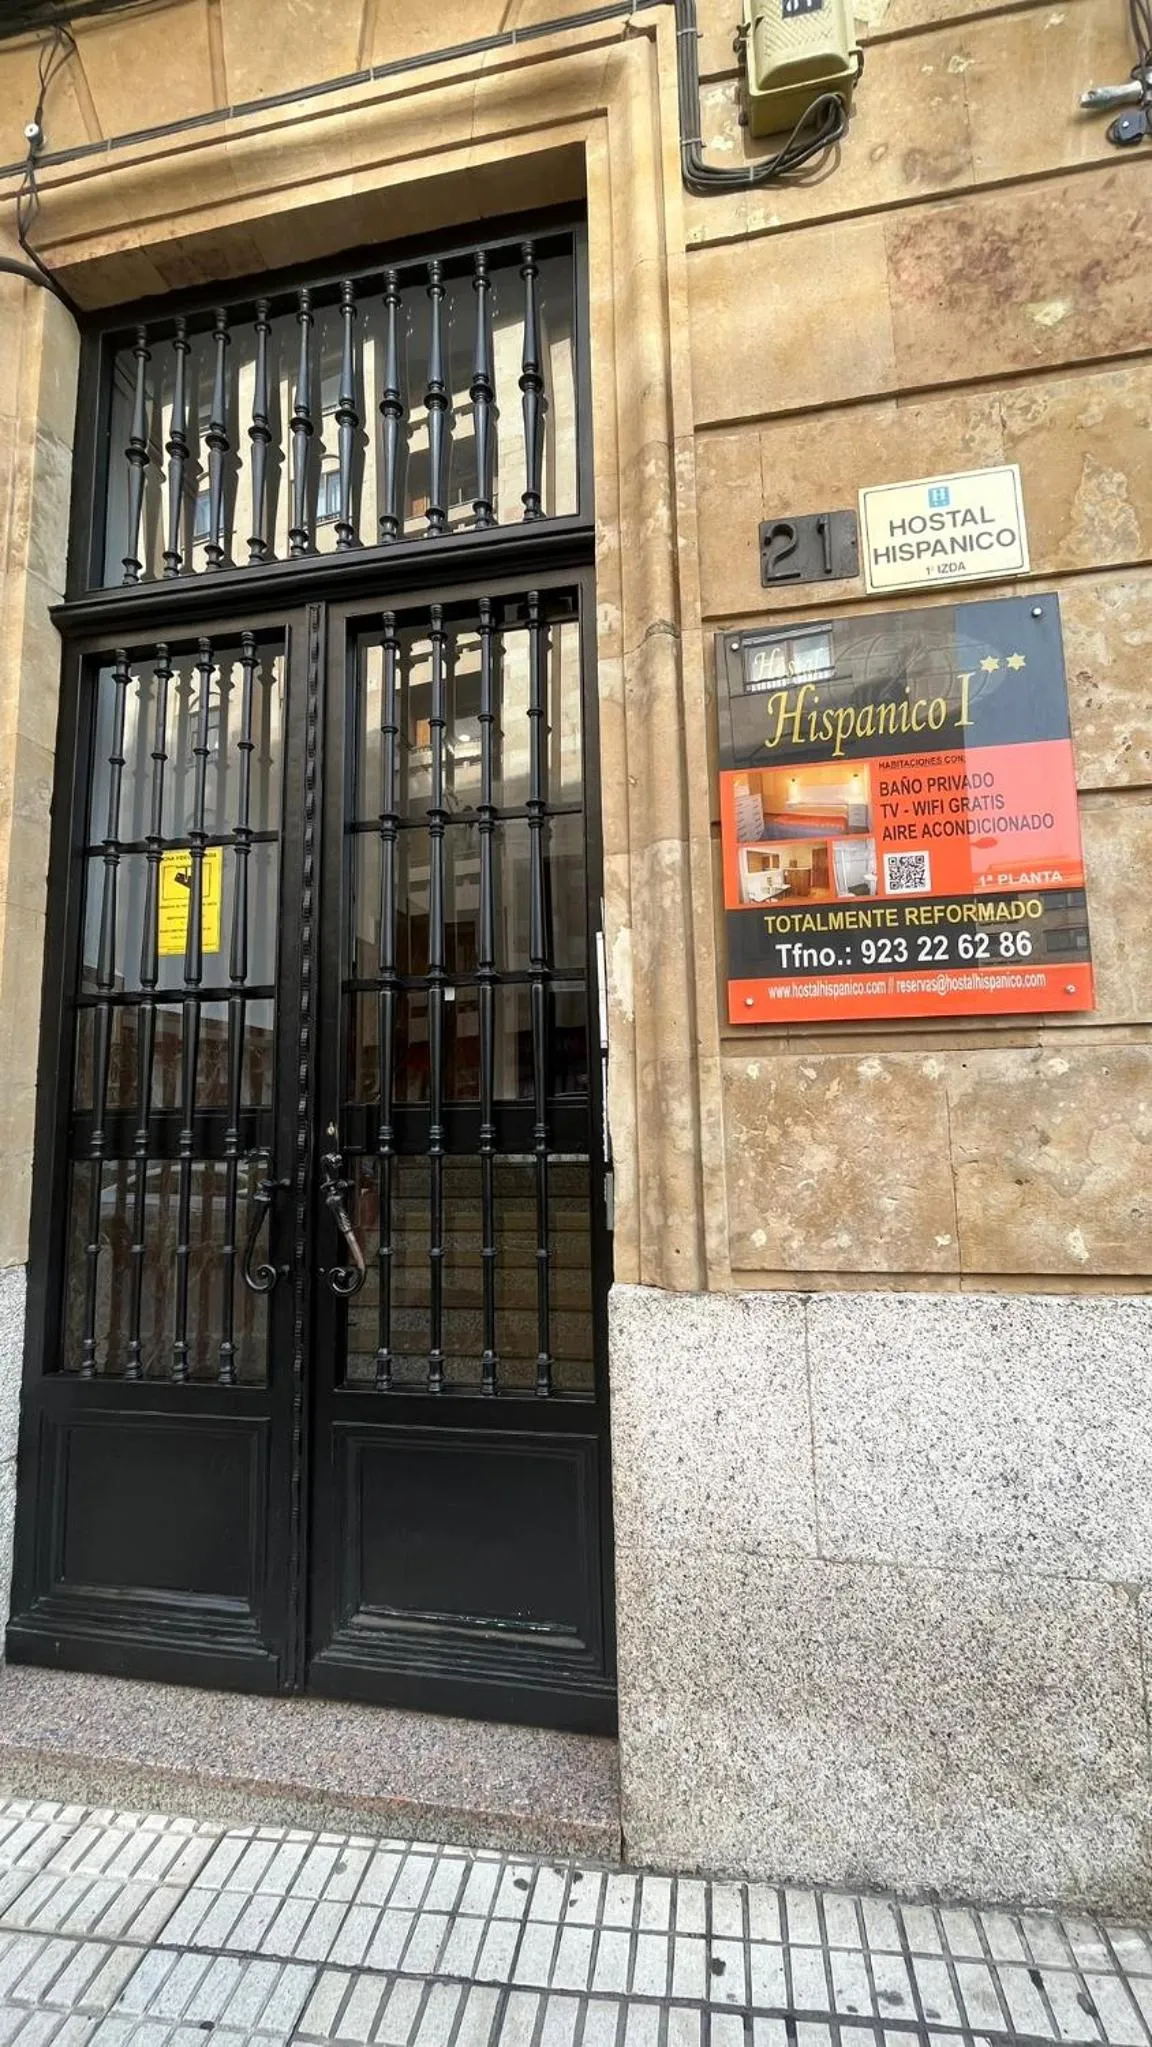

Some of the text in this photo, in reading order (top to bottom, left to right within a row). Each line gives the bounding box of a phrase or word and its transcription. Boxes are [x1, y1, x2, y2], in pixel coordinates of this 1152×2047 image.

[889, 506, 995, 537] HOSTAL
[763, 514, 832, 582] 21
[873, 528, 1016, 566] HISPANICO
[937, 561, 967, 574] IZDA
[765, 671, 977, 756] Hispanico I
[879, 756, 943, 770] HABITACIONES
[880, 772, 994, 797] BAÑO PRIVADO
[880, 803, 899, 819] TV
[912, 799, 944, 817] WIFI
[949, 794, 1005, 813] GRATIS
[883, 813, 1054, 841] AIRE ACONDICIONADO
[998, 870, 1063, 885] PLANTA
[764, 899, 1042, 934] TOTALMENTE REFORMADO
[775, 930, 1032, 968] Tfno.: 923 22 62 86
[768, 977, 886, 1000] www.hostalhispanico.com
[896, 973, 1046, 996] reservas@hostalhispanico.com
